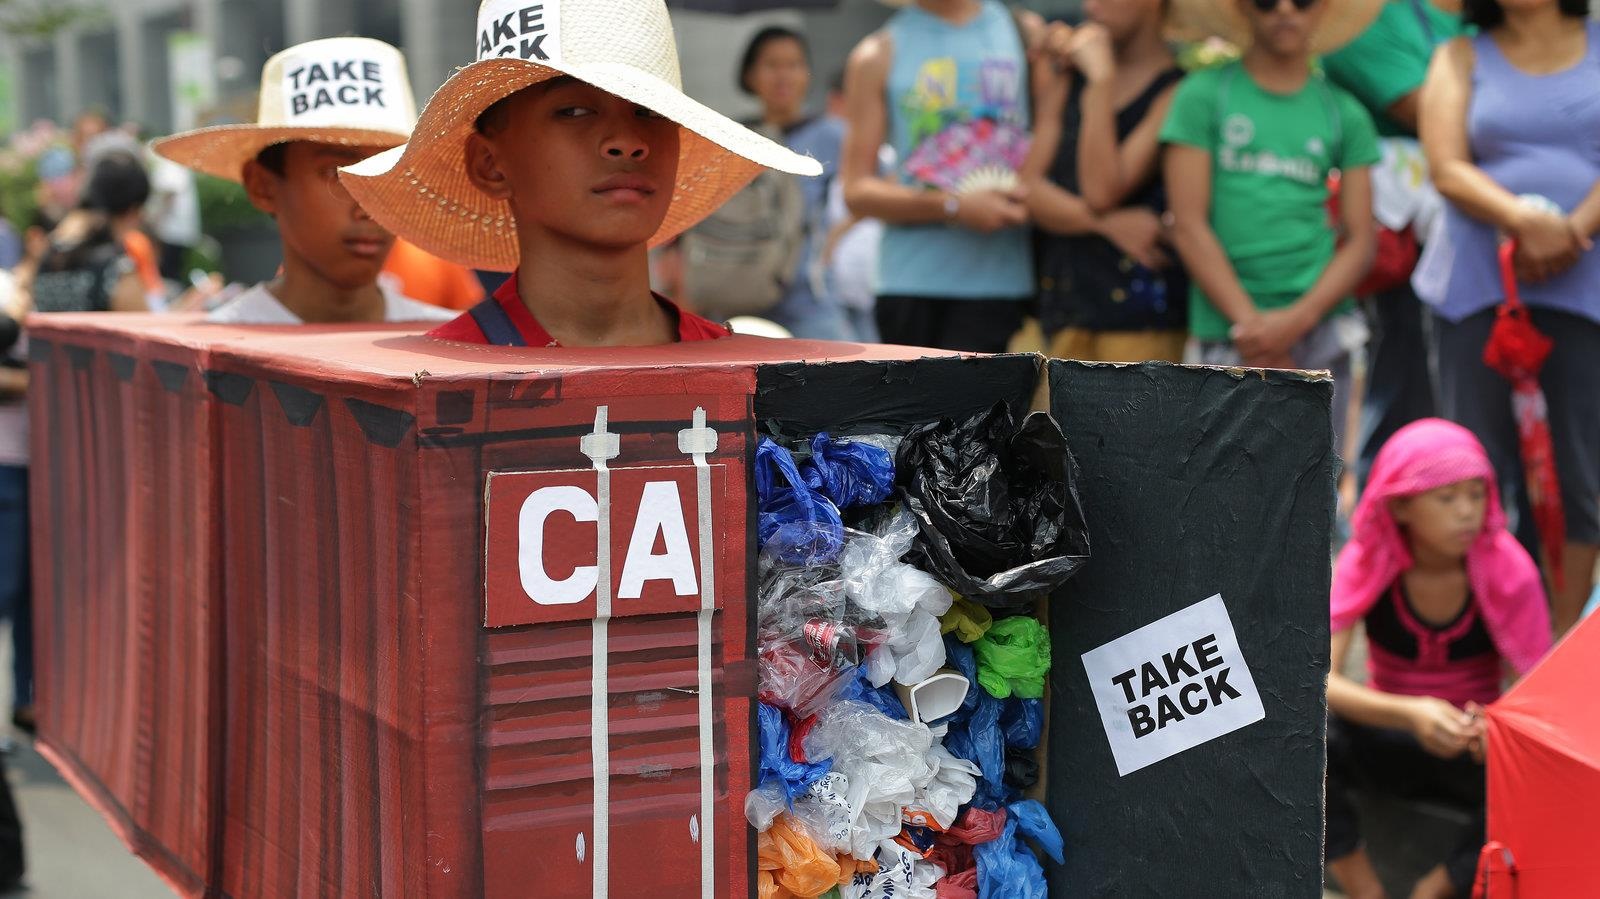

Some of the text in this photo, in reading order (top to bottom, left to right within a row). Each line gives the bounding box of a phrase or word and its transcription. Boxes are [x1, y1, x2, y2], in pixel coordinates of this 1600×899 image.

[480, 4, 545, 58] AKE
[288, 60, 382, 89] TAKE
[291, 86, 385, 116] BACK
[518, 480, 699, 605] CA
[1111, 633, 1225, 704] TAKE
[1126, 667, 1242, 739] BACK
